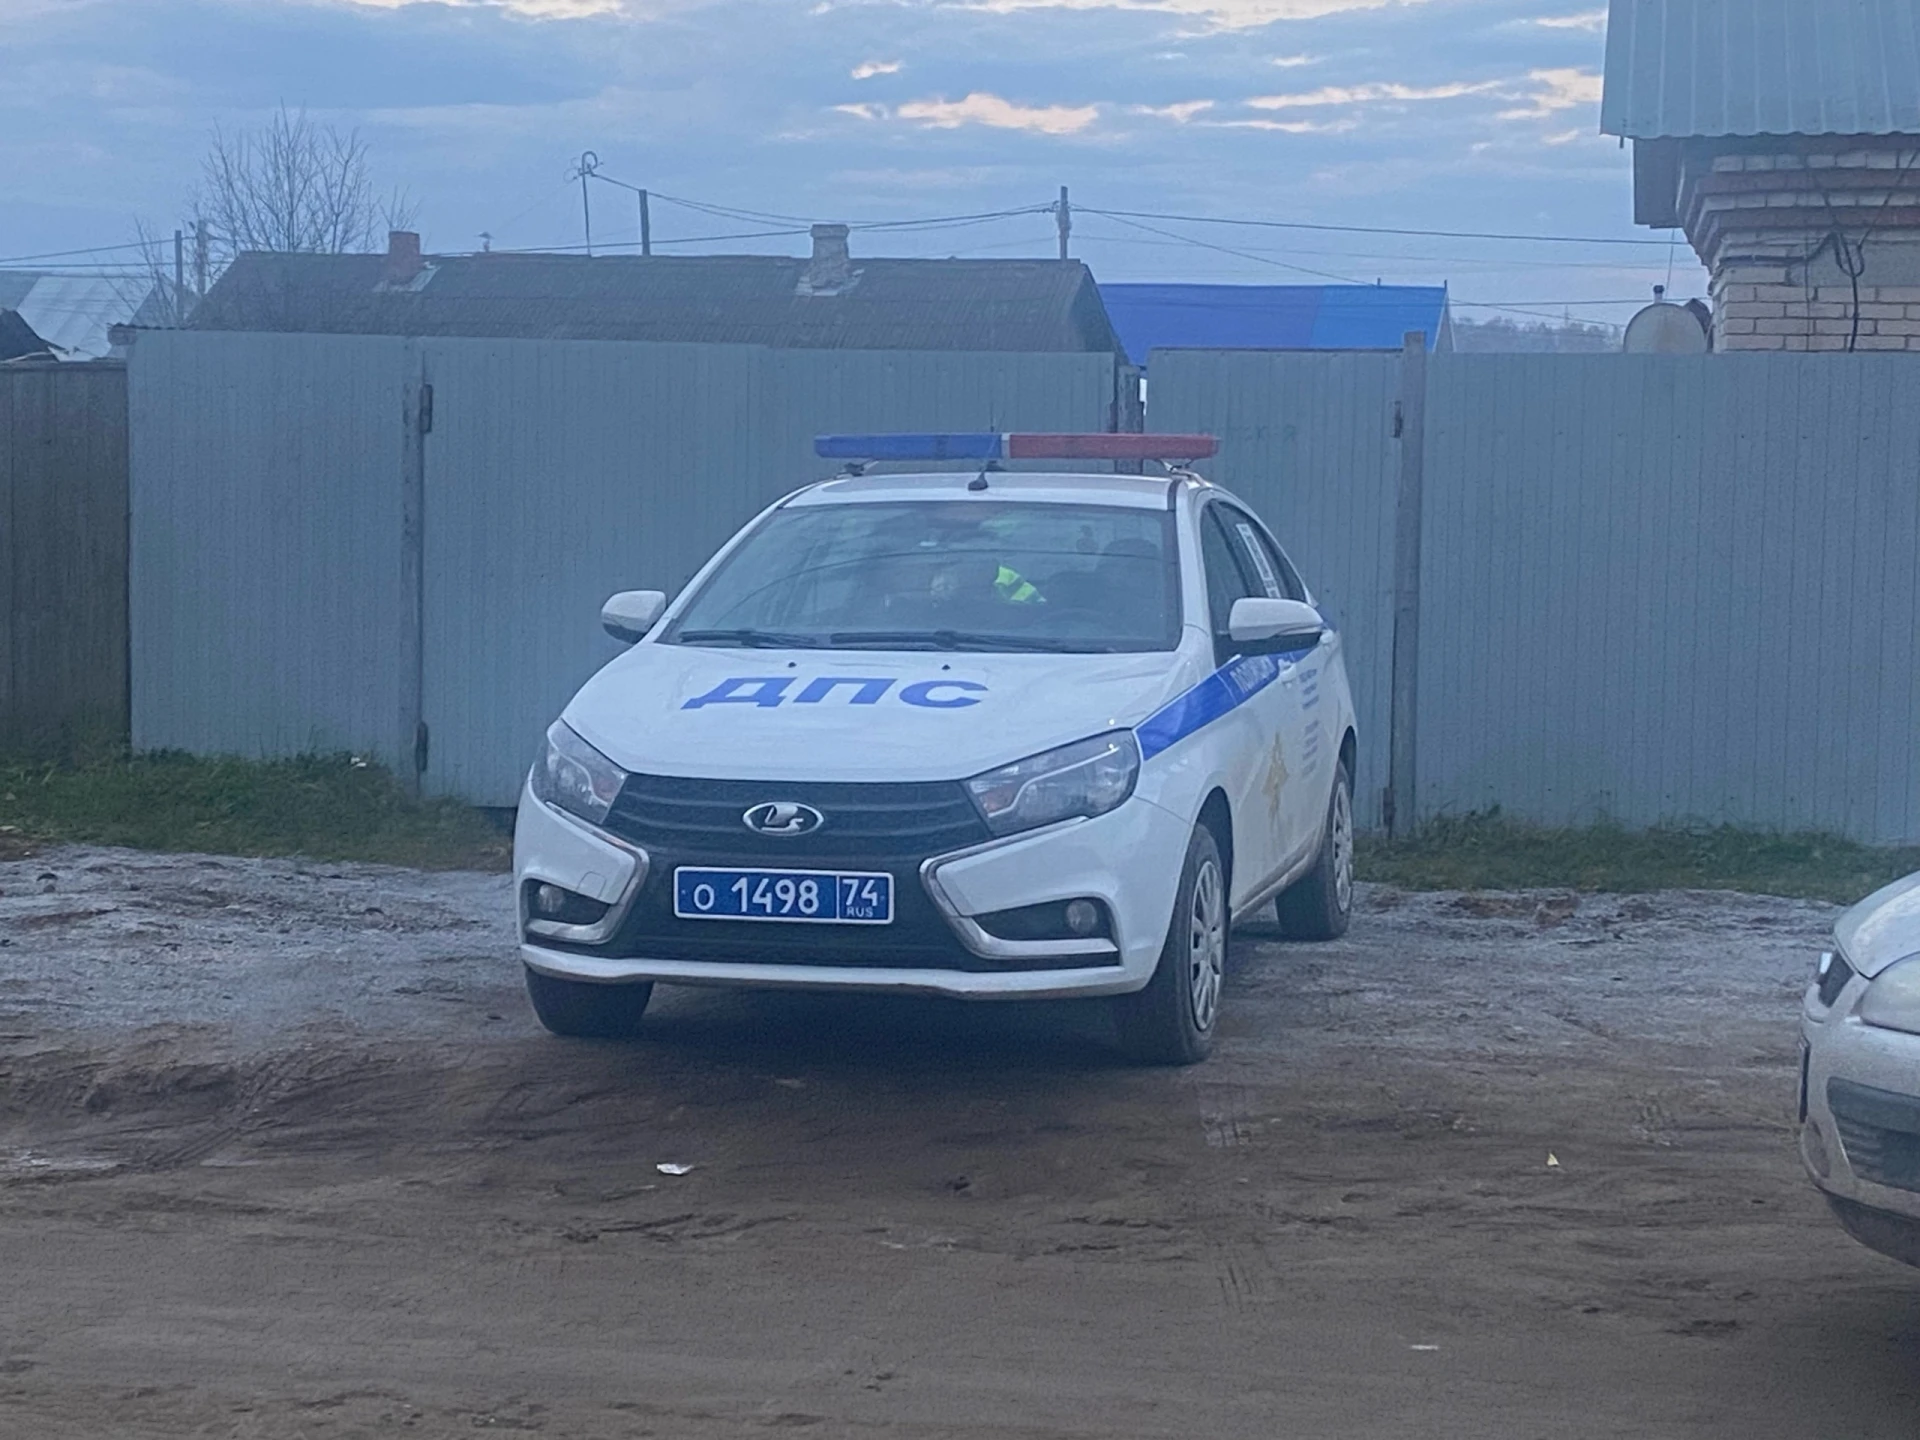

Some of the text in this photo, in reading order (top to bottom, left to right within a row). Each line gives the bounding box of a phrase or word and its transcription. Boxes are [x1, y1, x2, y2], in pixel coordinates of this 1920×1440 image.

[680, 677, 989, 710] ДПС
[730, 876, 820, 915] 1498
[842, 878, 879, 907] 74
[846, 906, 874, 919] RUS
